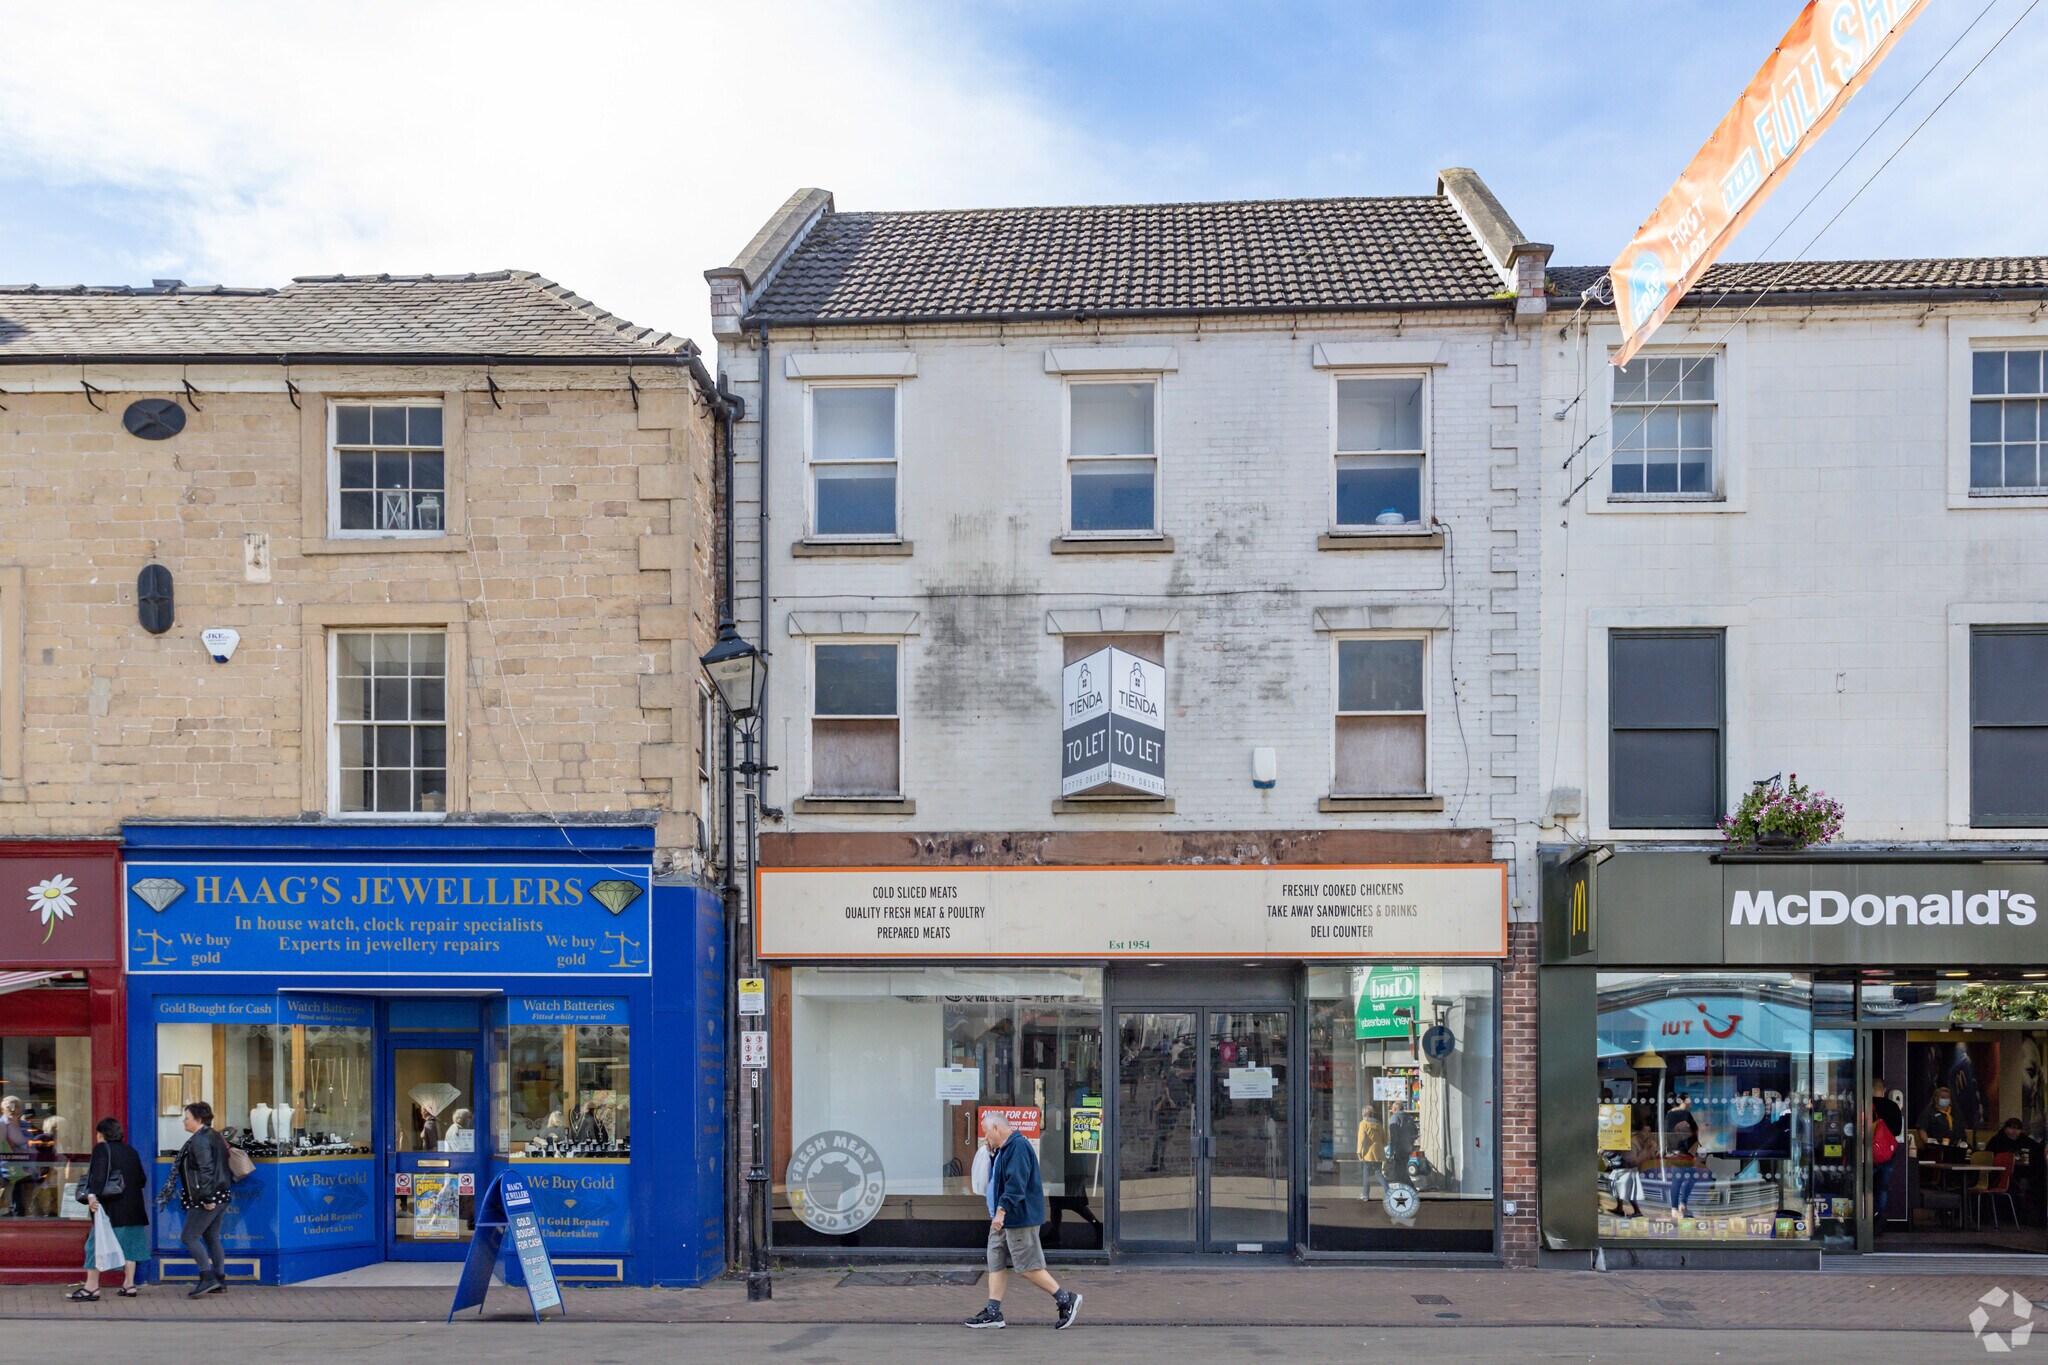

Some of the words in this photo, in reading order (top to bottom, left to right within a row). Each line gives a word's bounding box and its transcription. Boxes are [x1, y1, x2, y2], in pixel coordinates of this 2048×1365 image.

[1726, 159, 1752, 198] THE
[1753, 44, 1832, 170] FULL
[1068, 691, 1103, 717] TIENDA
[1118, 690, 1158, 717] TIENDA
[1066, 740, 1083, 764] TO
[1085, 729, 1106, 758] LET
[1115, 729, 1135, 756] TO
[1138, 737, 1161, 764] LET
[194, 875, 341, 905] HAAG’S
[351, 877, 584, 906] JEWELLERS
[872, 886, 895, 899] COLD
[897, 886, 927, 899] SLICED
[929, 886, 958, 899] MEATS
[1282, 884, 1320, 897] FRESHLY
[1322, 884, 1357, 897] COOKED
[1360, 883, 1404, 896] CHICKENS
[845, 906, 881, 920] QUALITY
[883, 906, 911, 919] FRESH
[913, 906, 936, 919] MEAT
[939, 906, 945, 919] &
[947, 906, 986, 919] POULTRY
[1266, 905, 1288, 918] TAKE
[1290, 905, 1314, 918] AWAY
[1316, 904, 1374, 918] SANDWICHES
[1376, 904, 1383, 917] &
[1384, 904, 1418, 917] DRINKS
[1730, 889, 2037, 926] McDonald's
[234, 915, 252, 930] In
[257, 915, 303, 931] house
[307, 916, 360, 932] watch,
[363, 917, 405, 932] clock
[410, 917, 459, 935] repair
[463, 917, 543, 936] specialists
[1310, 925, 1330, 939] DELI
[1332, 925, 1374, 938] COUNTER
[877, 927, 920, 940] PREPARED
[922, 926, 951, 939] MEATS
[180, 933, 202, 946] We
[206, 933, 232, 948] buy
[278, 936, 341, 953] Experts
[345, 937, 361, 951] in
[364, 937, 438, 955] jewellery
[443, 938, 500, 955] repairs
[546, 935, 568, 947] We
[571, 935, 597, 950] buy
[1108, 940, 1125, 950] Est
[1127, 940, 1150, 950] 1954
[191, 951, 221, 966] gold
[556, 953, 586, 968] gold
[159, 1002, 187, 1014] Gold
[188, 1003, 227, 1016] Bought
[228, 1003, 244, 1014] for
[246, 1003, 272, 1014] Cash
[287, 1000, 320, 1013] Watch
[523, 1000, 560, 1011] Watch
[563, 1000, 615, 1011] Batteries
[575, 1014, 589, 1022] you
[1005, 1110, 1022, 1120] FOR
[1022, 1110, 1038, 1120] £10
[792, 1137, 828, 1182] FRESH
[832, 1135, 875, 1165] MEAT
[289, 1174, 310, 1188] We
[312, 1173, 336, 1190] Buy
[337, 1171, 367, 1185] Gold
[527, 1175, 549, 1189] We
[552, 1176, 579, 1192] Buy
[581, 1176, 615, 1190] Gold
[843, 1208, 865, 1226] TO
[864, 1182, 880, 1207] GO
[293, 1215, 307, 1224] All
[308, 1213, 329, 1224] Gold
[331, 1212, 363, 1225] Repairs
[516, 1216, 531, 1227] GOLD
[546, 1217, 571, 1227] Gold
[573, 1218, 609, 1228] Repairs
[303, 1224, 354, 1236] Undertaken
[515, 1227, 537, 1239] BOUGHT
[541, 1229, 599, 1238] Undertaken
[517, 1240, 528, 1250] FOR
[527, 1237, 542, 1248] CASH
